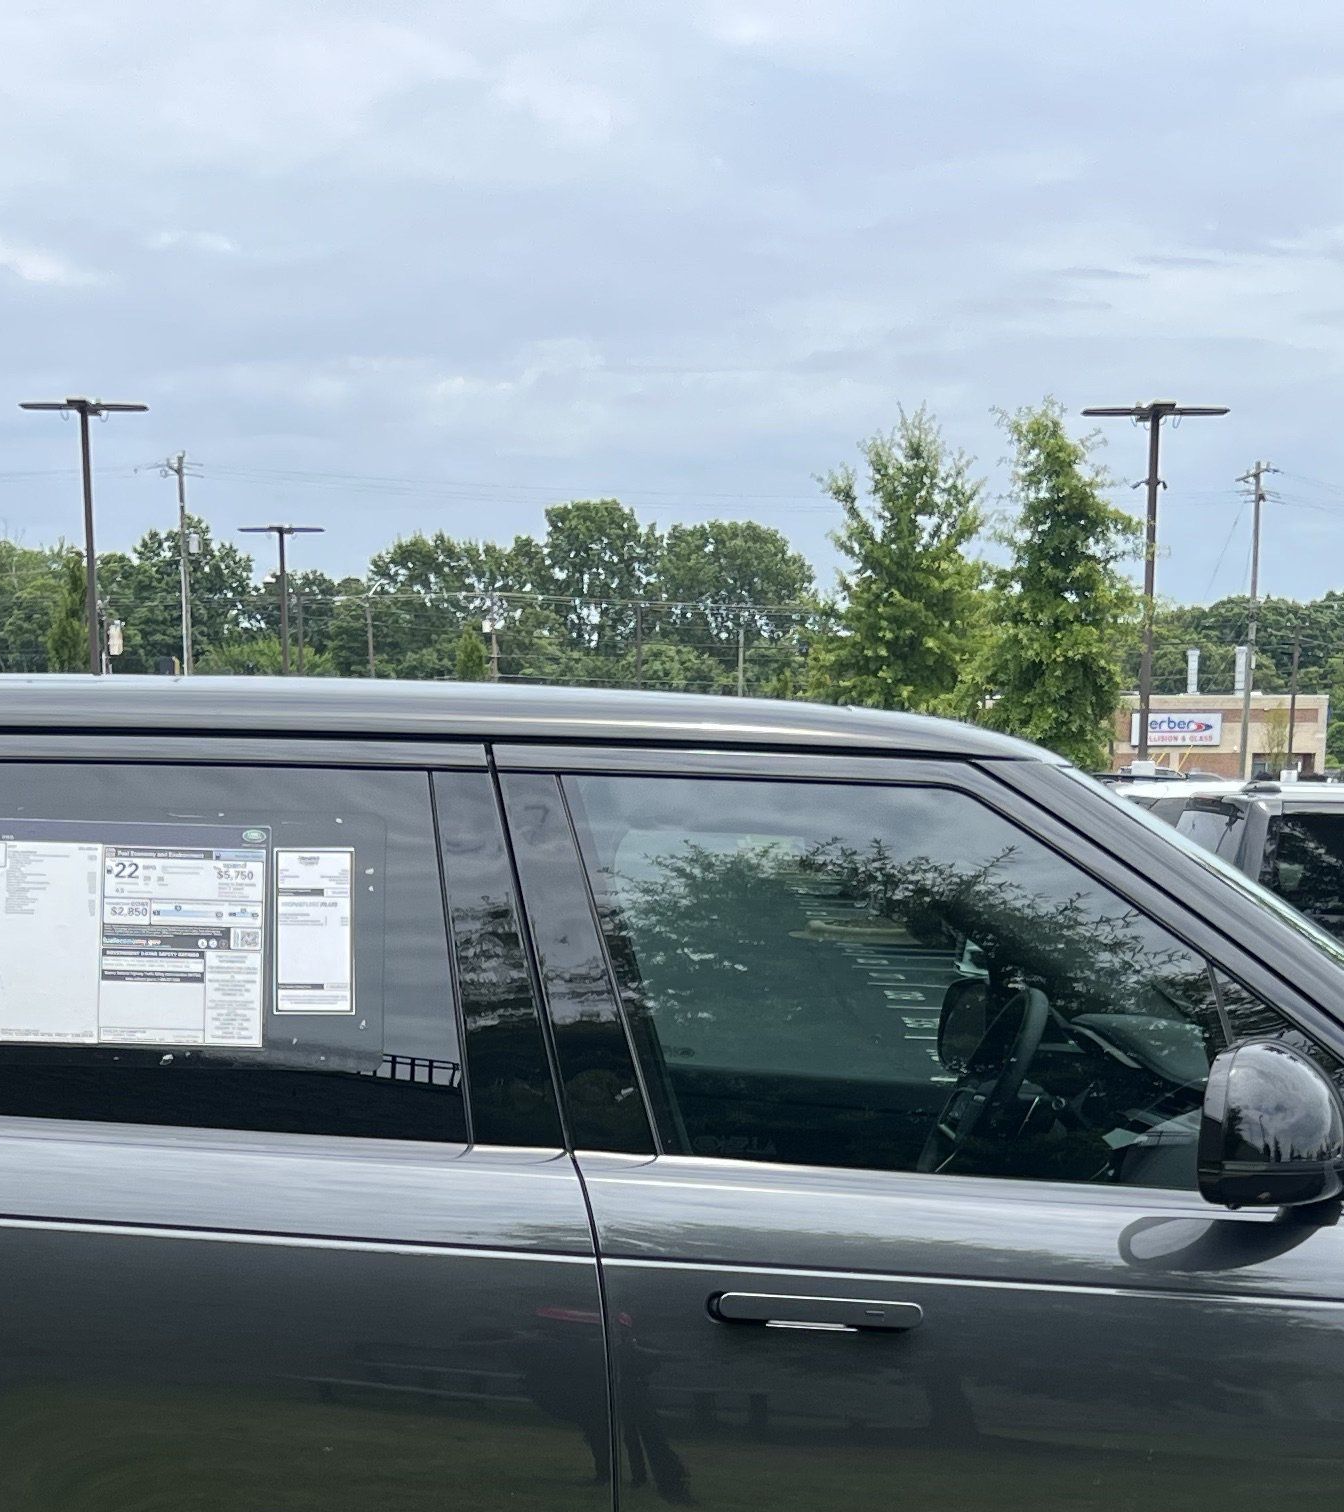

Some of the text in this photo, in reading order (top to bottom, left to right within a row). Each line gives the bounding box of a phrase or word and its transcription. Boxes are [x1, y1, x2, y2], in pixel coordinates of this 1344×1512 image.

[1149, 716, 1195, 730] erber
[1149, 734, 1178, 743] LLISION
[1189, 735, 1213, 743] GLASS
[115, 862, 139, 879] 22
[216, 870, 254, 881] $5,750
[110, 906, 148, 918] $2,850
